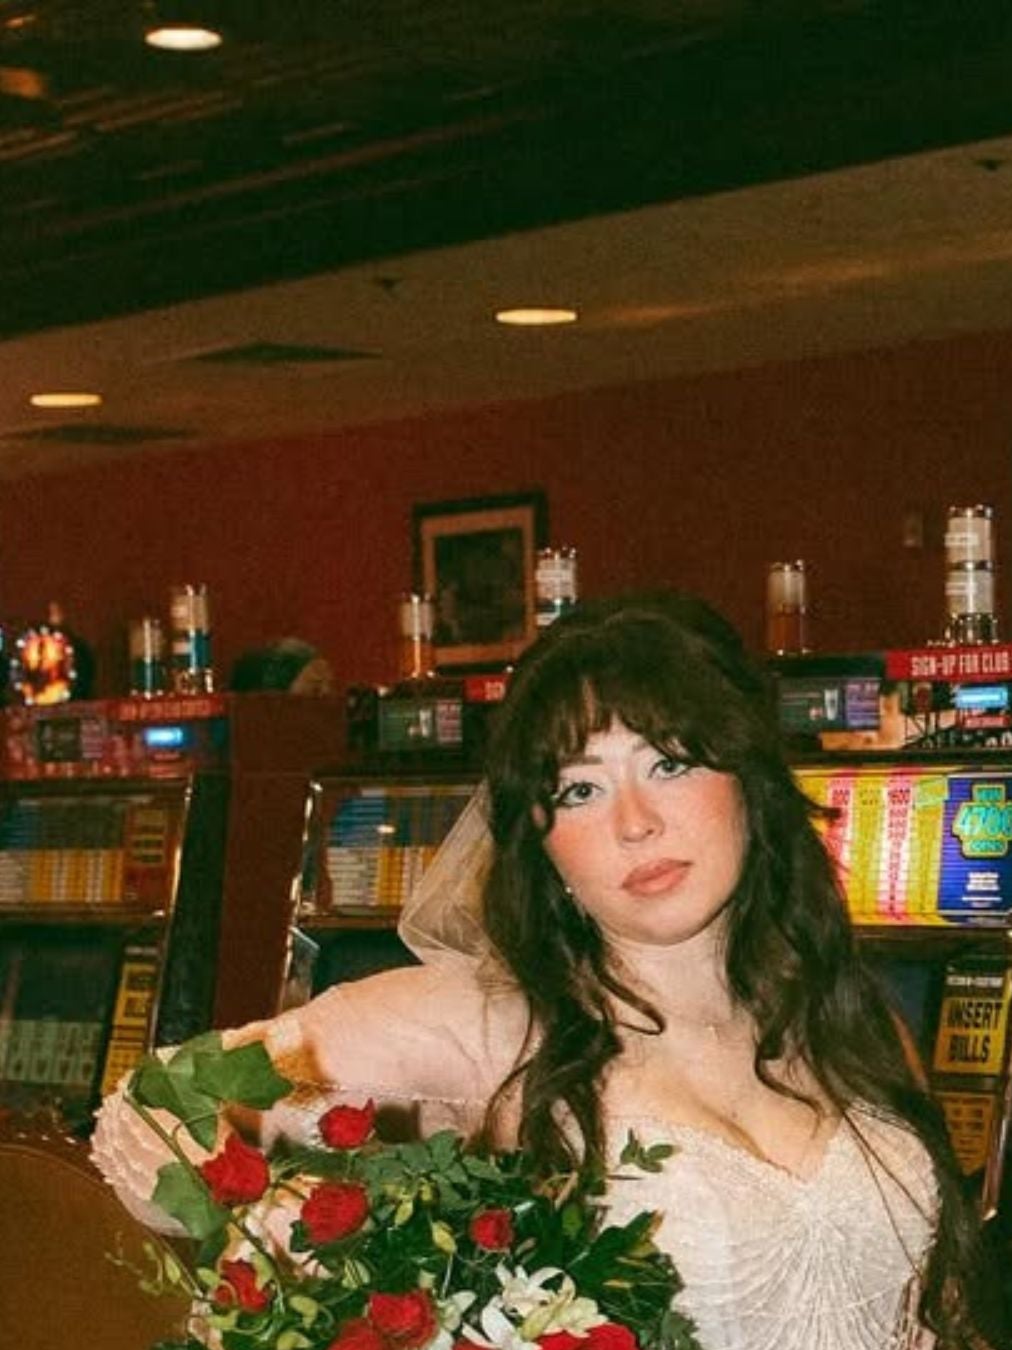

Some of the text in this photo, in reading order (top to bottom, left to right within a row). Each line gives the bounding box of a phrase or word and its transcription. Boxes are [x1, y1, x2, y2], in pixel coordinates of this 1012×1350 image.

[910, 655, 956, 676] SIGN-UP
[959, 653, 980, 674] FOR
[982, 651, 1008, 672] CLUB
[948, 1001, 1003, 1029] INSERT
[949, 1035, 992, 1063] BILLS
